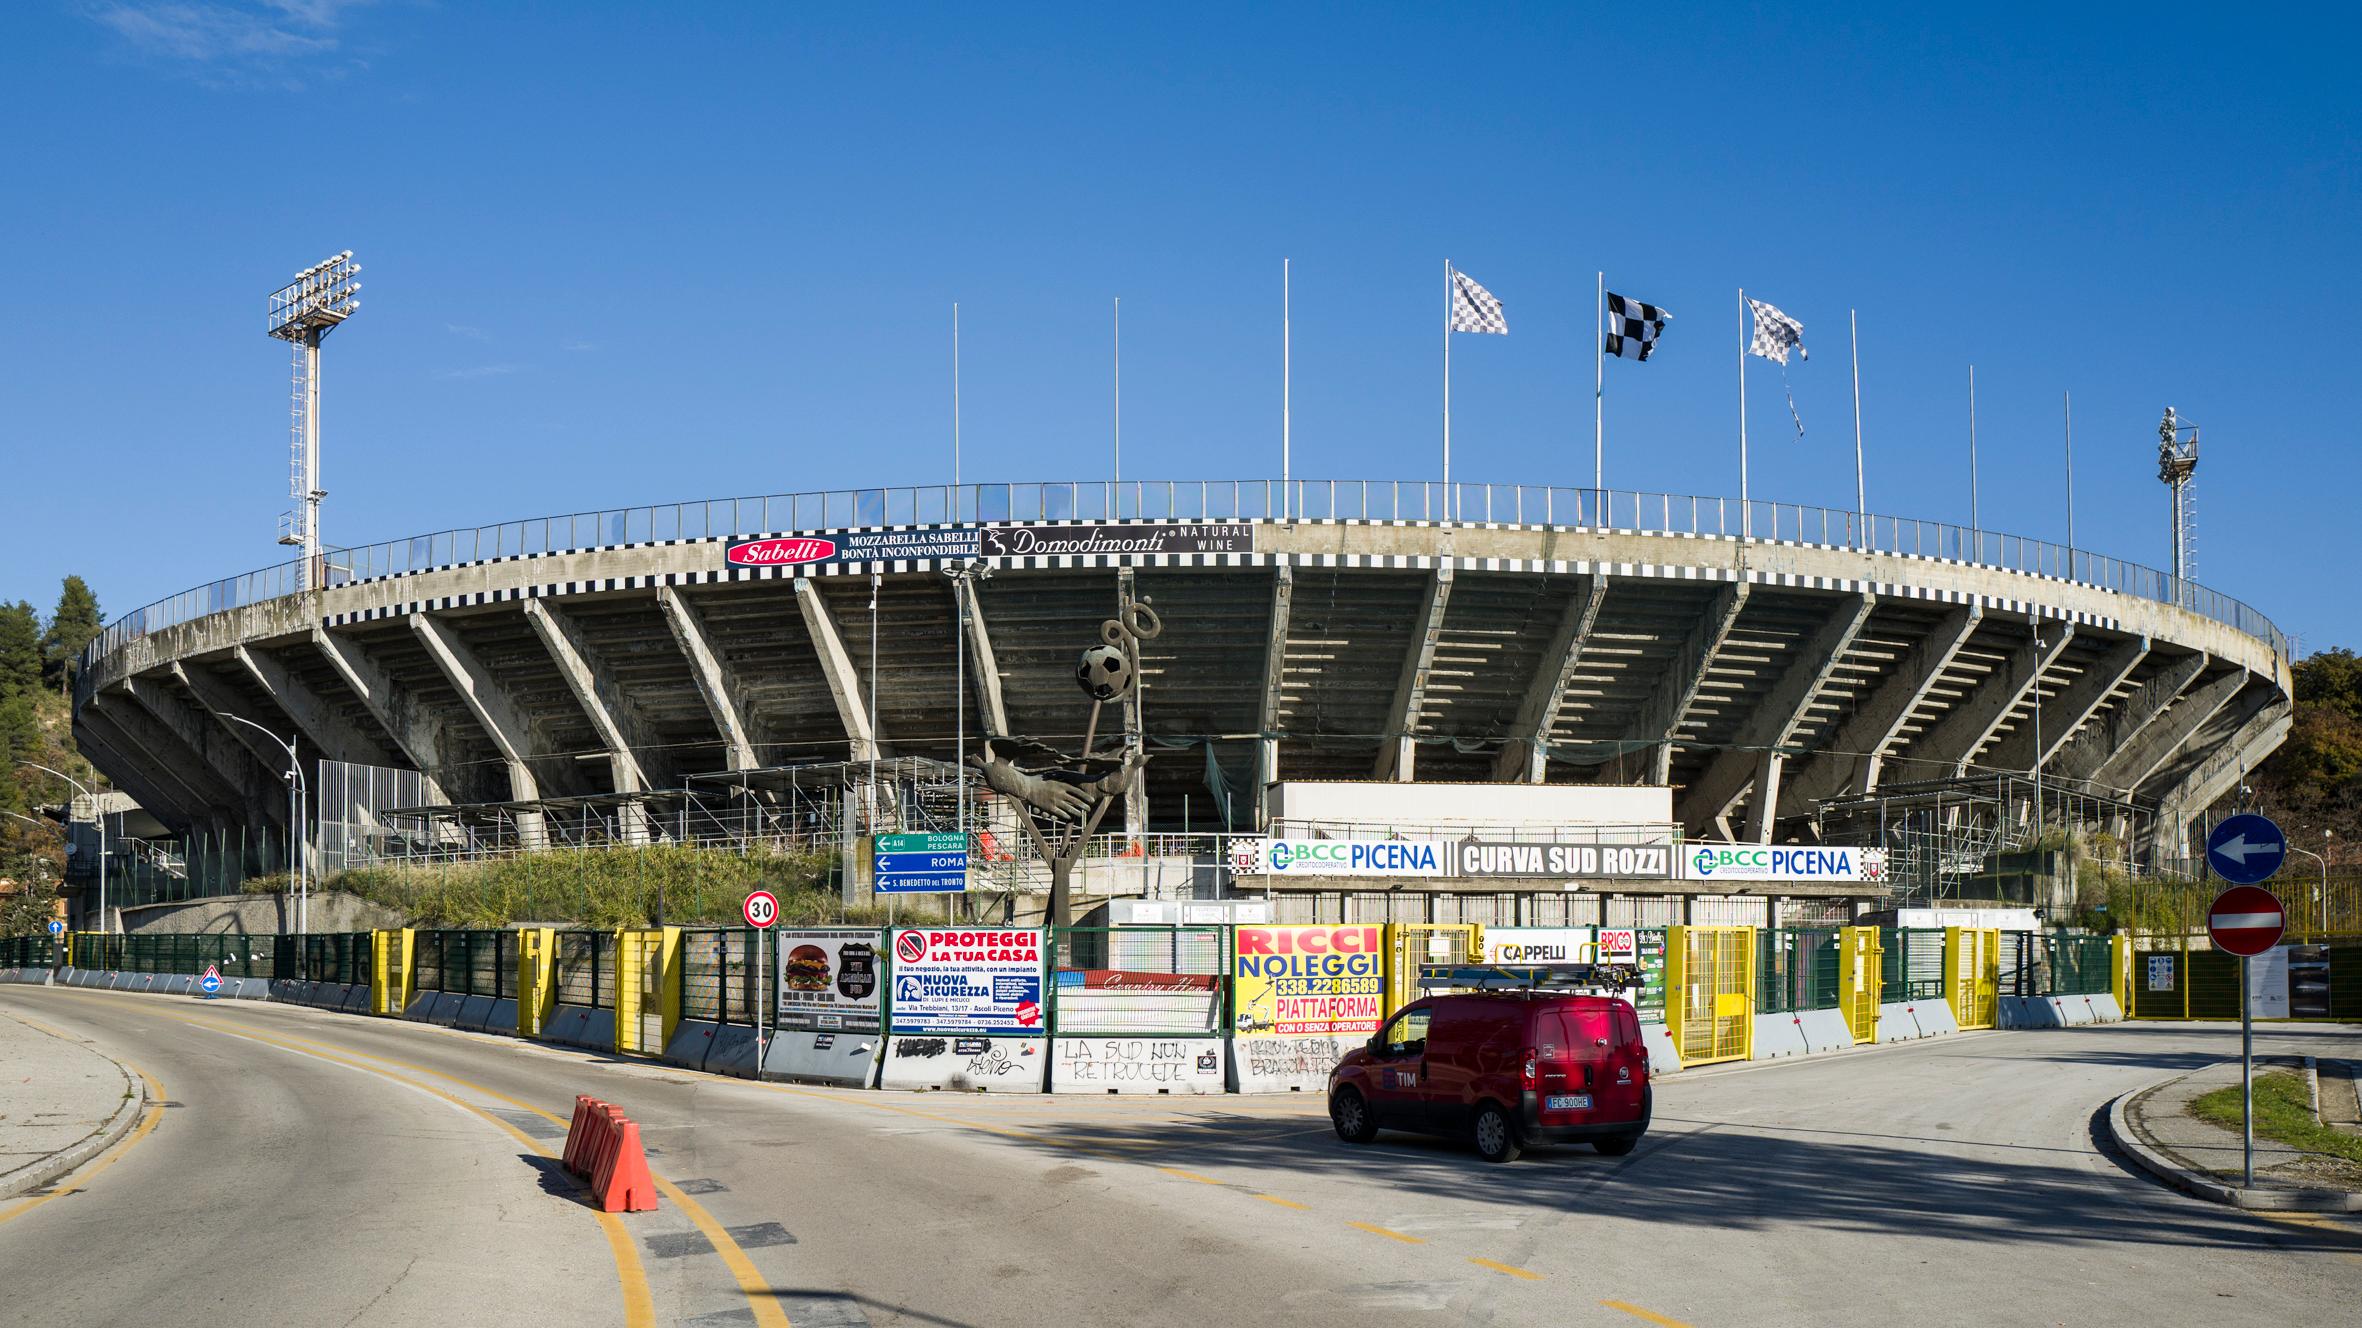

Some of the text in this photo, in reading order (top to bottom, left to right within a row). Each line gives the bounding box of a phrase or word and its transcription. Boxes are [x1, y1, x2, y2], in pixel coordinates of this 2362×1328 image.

[1180, 526, 1249, 537] NATURAL
[849, 532, 979, 548] MOZZARELLA SABELLI
[1013, 528, 1166, 553] Domodimonti
[1197, 539, 1233, 551] WINE
[743, 542, 820, 563] Sabelli
[841, 543, 979, 560] BONTÀ INCONFONDIBILE
[893, 839, 904, 847] A14
[928, 834, 965, 842] BOLOGNA
[928, 842, 963, 850] PESCARA
[931, 858, 965, 867] ROMA
[1296, 844, 1437, 870] BCC PICENA
[1464, 845, 1667, 875] CURVA SUD ROZZI
[1720, 850, 1852, 875] BCC PICENA
[900, 878, 931, 887] BENEDETTO
[932, 879, 940, 887] DEL
[942, 878, 963, 886] TRONTO
[752, 902, 772, 918] 30
[930, 932, 1037, 947] PROTEGGI
[1238, 928, 1378, 955] RICCI
[932, 949, 1038, 962] LA TUA CASA
[1504, 945, 1566, 960] CAPPELLI
[1238, 954, 1378, 977] NOLEGGI
[923, 975, 968, 986] NUOVA
[1278, 978, 1378, 994] 338.2286589
[923, 986, 990, 997] SICUREZZA
[1277, 997, 1378, 1019] PIATTAFORMA
[1278, 1021, 1377, 1033] CON O SENZA OPERATORE
[1065, 1040, 1092, 1059] LA
[1106, 1041, 1143, 1060] SUD
[1397, 1072, 1416, 1088] TIM
[1552, 1097, 1588, 1107] FC 900HE
